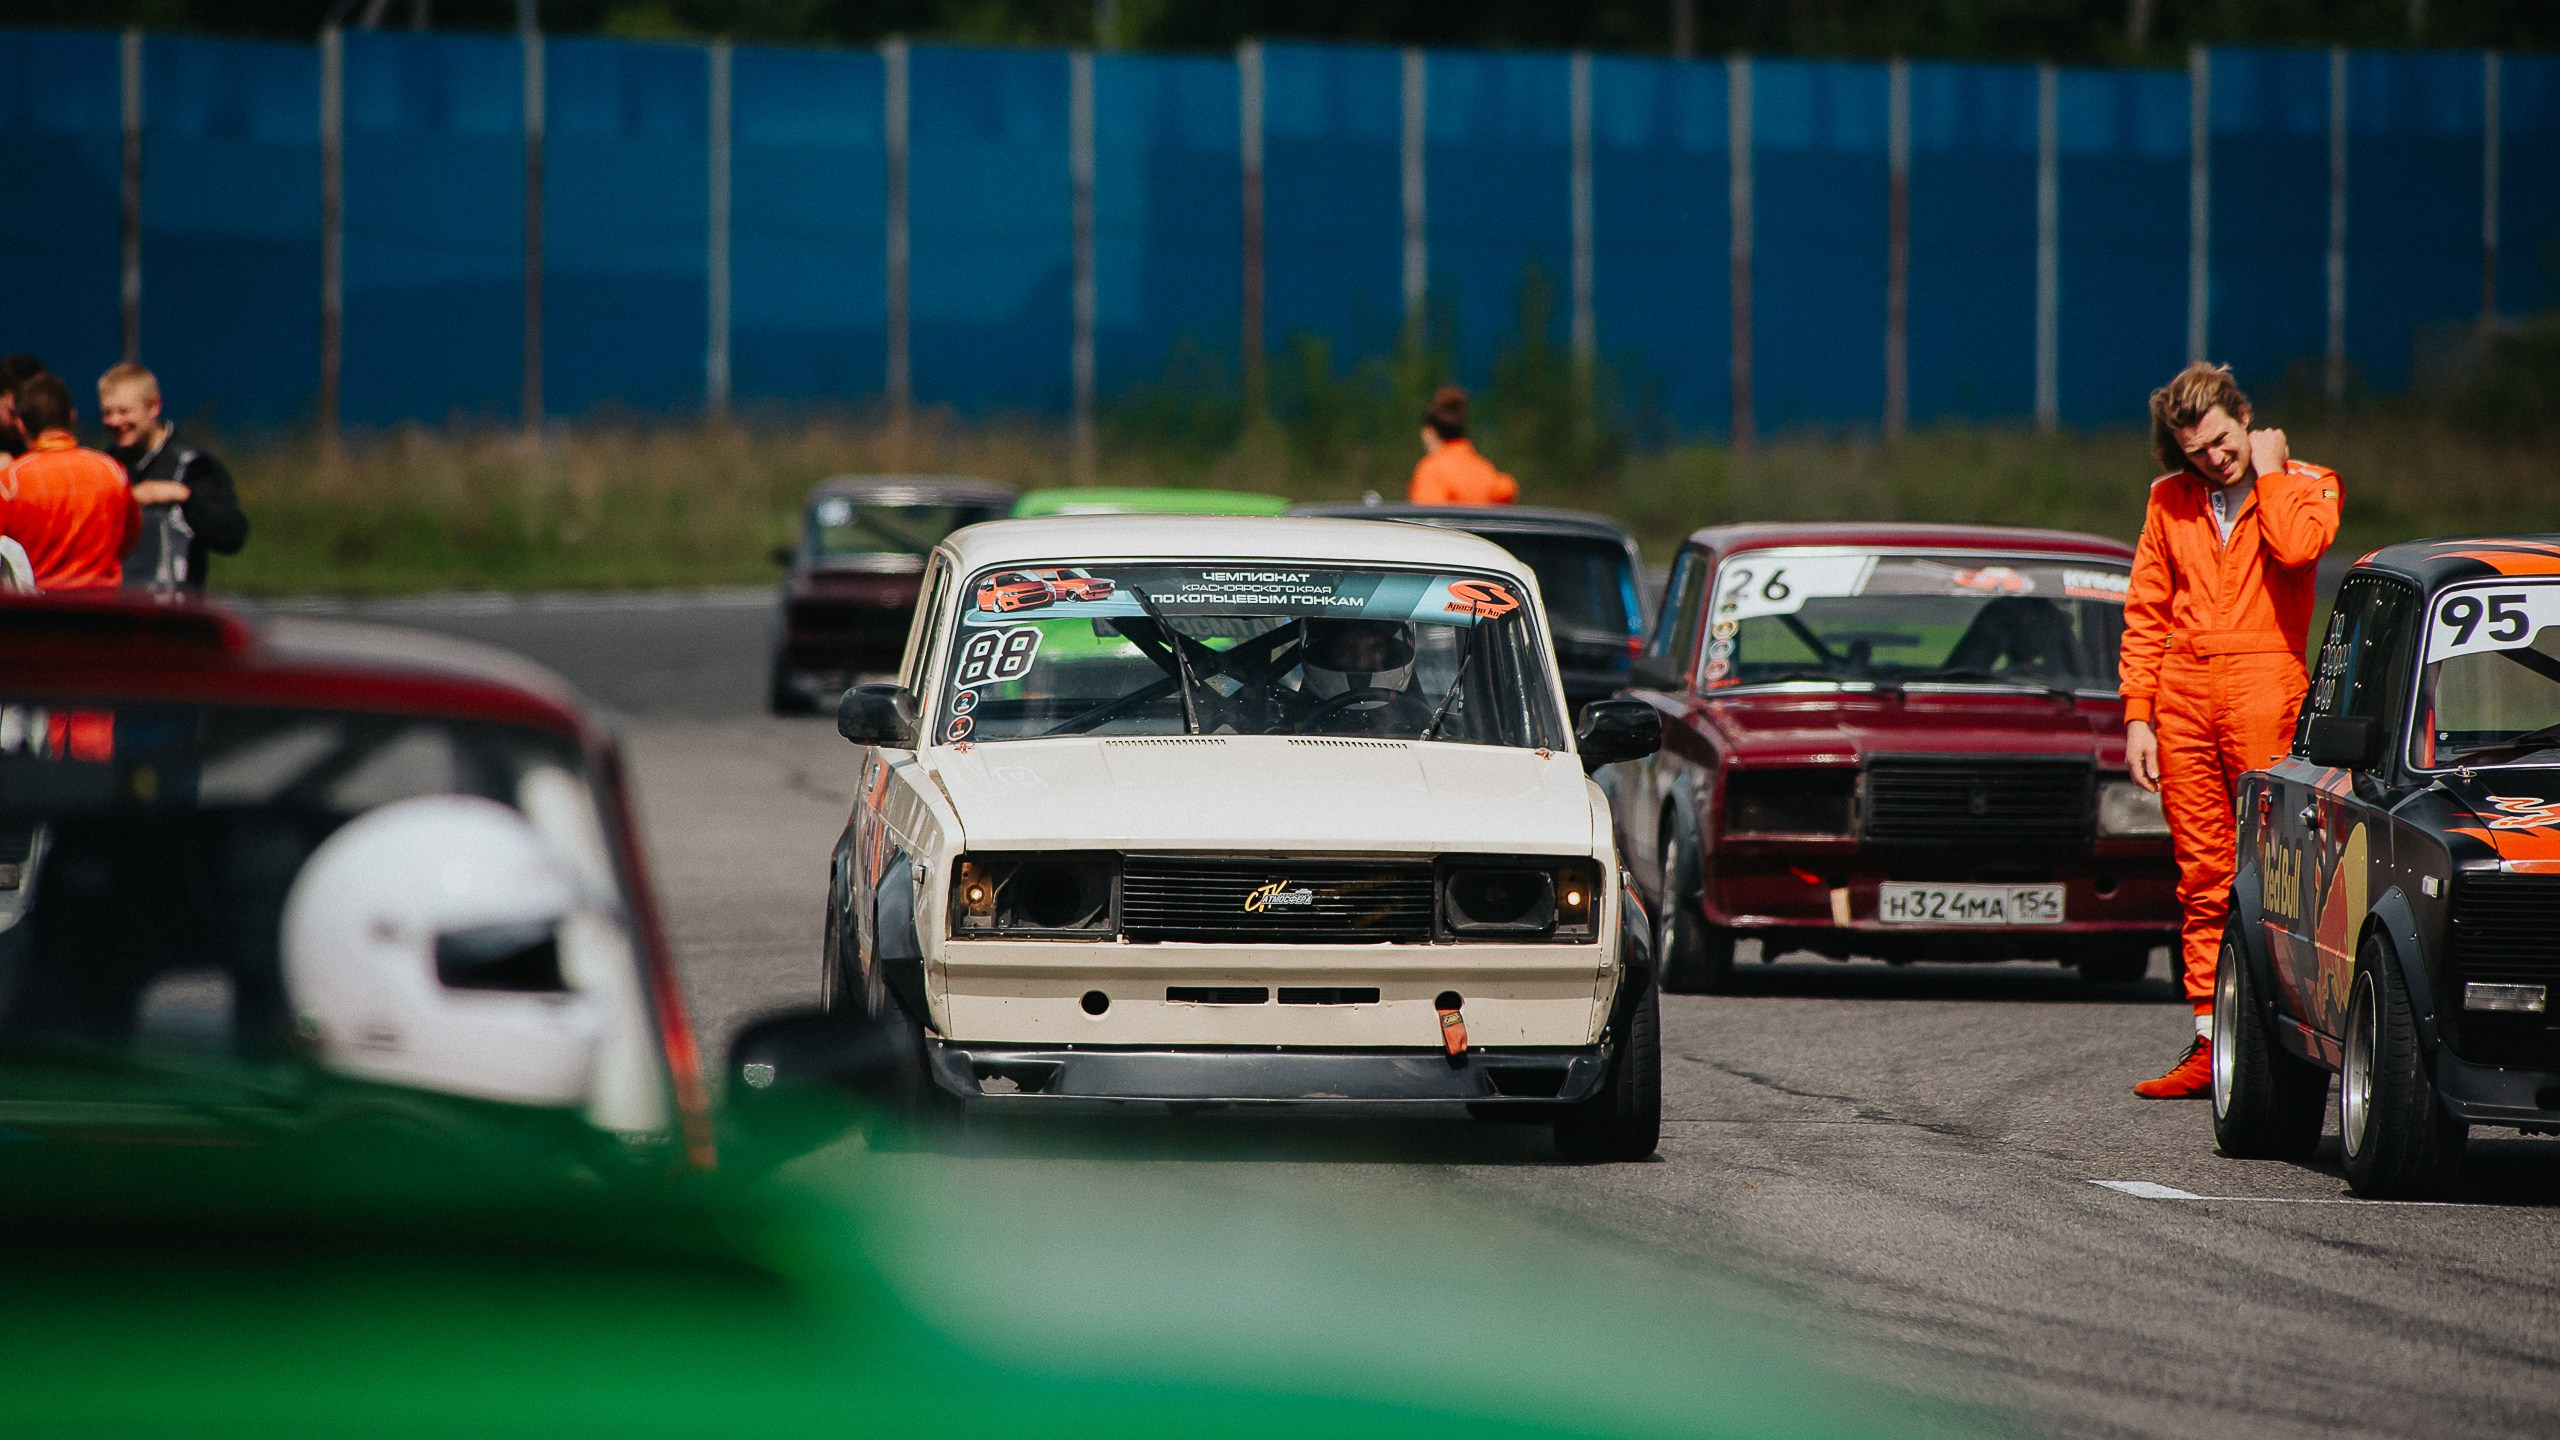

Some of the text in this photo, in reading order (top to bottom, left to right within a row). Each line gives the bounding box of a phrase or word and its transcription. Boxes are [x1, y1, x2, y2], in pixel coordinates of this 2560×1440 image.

[1202, 572, 1310, 583] ЧЕМПИОНАТ
[1726, 569, 1790, 600] 26
[1182, 584, 1332, 594] КРАСНОЯРСКОГО КРАЯ
[1151, 594, 1364, 607] ПО КОЛЬЦЕВЫМ ГОНКАМ
[2441, 594, 2530, 647] 95
[954, 626, 1043, 690] 88
[1262, 894, 1312, 903] АТМОСФЕРА
[2012, 891, 2058, 912] 154
